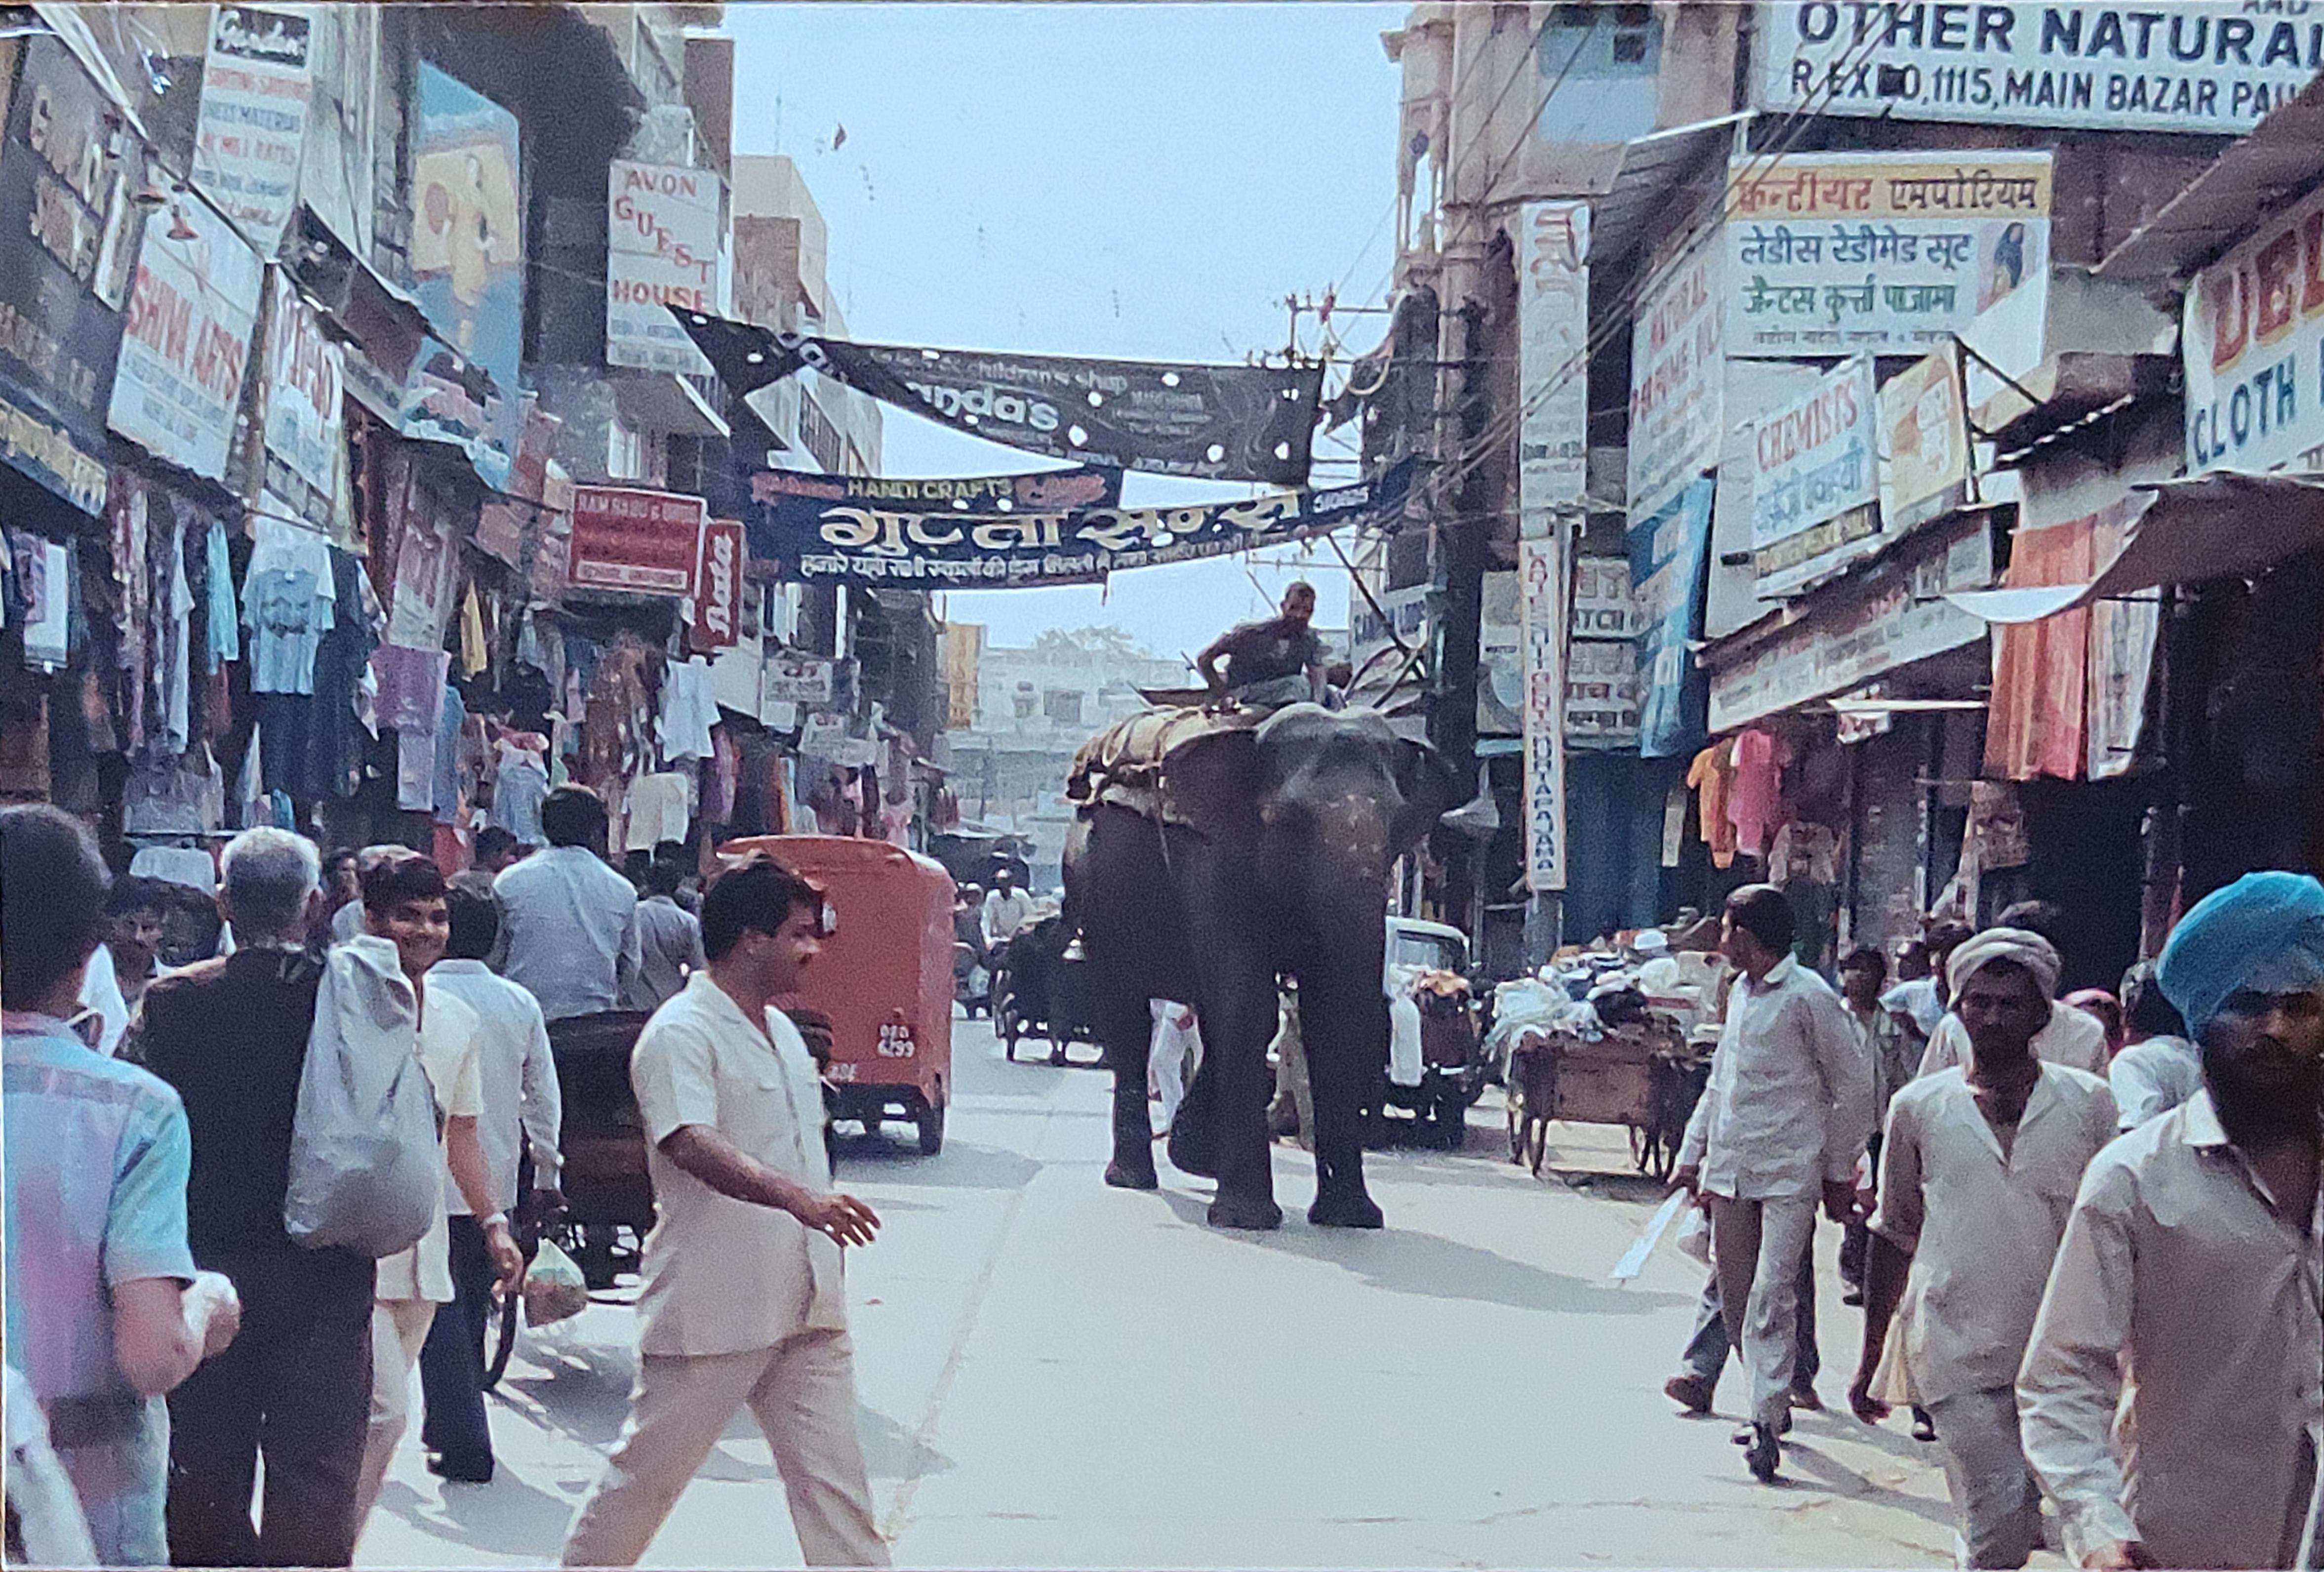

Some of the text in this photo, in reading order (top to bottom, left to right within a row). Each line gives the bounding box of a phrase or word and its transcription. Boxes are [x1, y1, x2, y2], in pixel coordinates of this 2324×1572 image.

[1798, 2, 2015, 52] OTHER
[2105, 74, 2217, 117] BAZAR
[625, 170, 697, 197] AVON
[615, 196, 715, 284] GUEST
[1740, 224, 1973, 271] लेडीस रेडीमेड सूट
[613, 279, 707, 313] HOUSE
[1883, 284, 1957, 313] पाजामा
[1758, 376, 1857, 473] CHEMISTS
[2195, 353, 2295, 466] CLOTH
[922, 477, 1012, 498] CRAFTS
[819, 506, 1069, 557] गुप्ता
[705, 530, 733, 639] Bata
